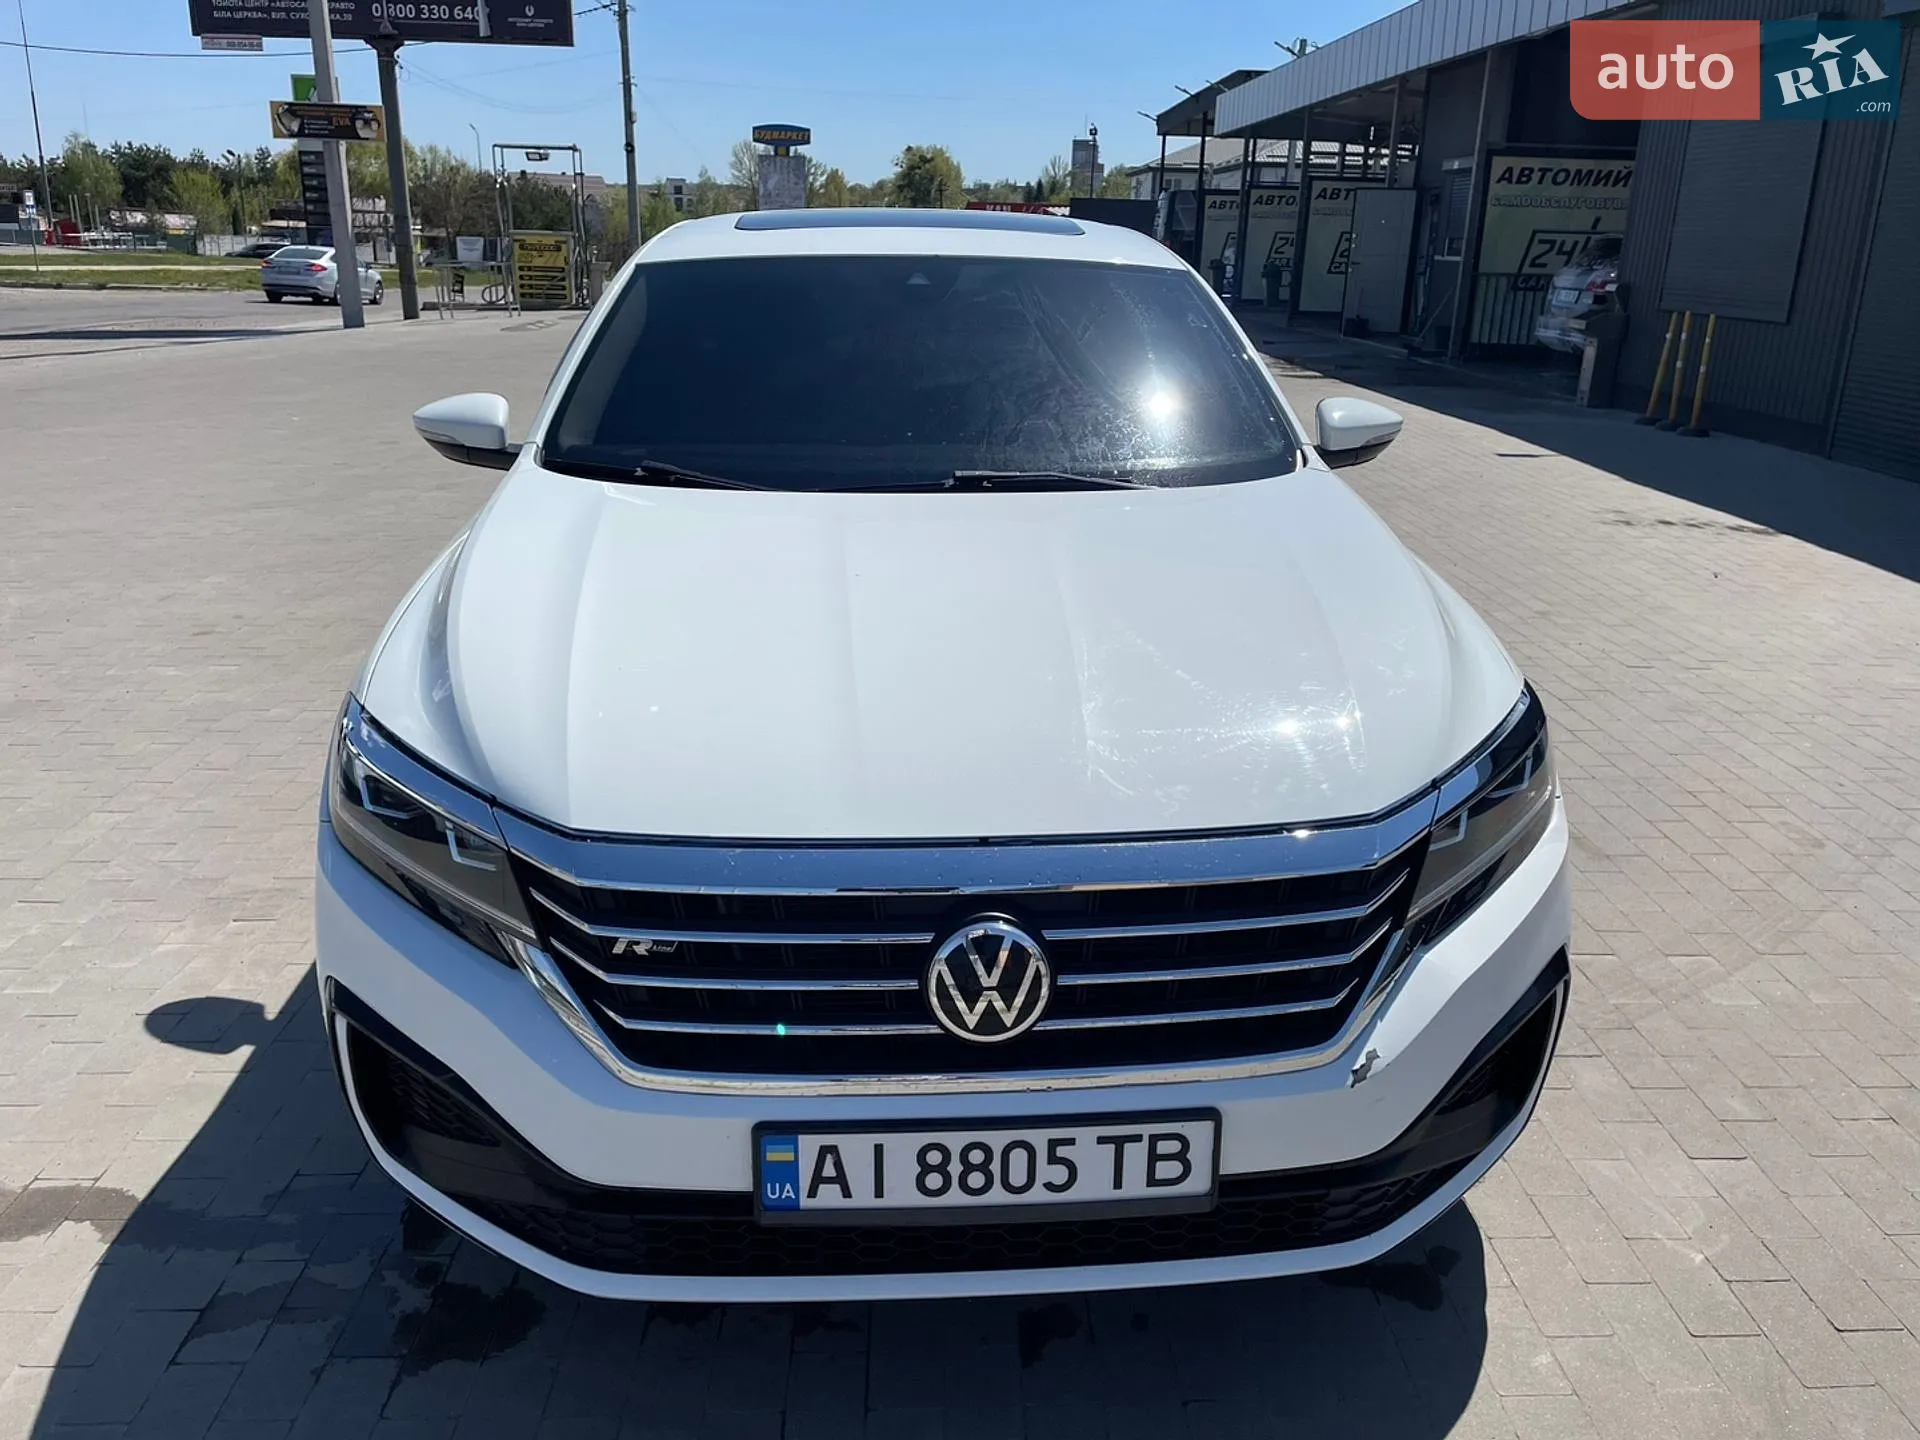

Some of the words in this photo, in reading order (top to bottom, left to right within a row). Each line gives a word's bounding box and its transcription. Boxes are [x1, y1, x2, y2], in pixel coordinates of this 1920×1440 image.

[420, 4, 450, 19] 330
[806, 1142, 884, 1200] AI
[915, 1137, 1078, 1198] 8805
[1096, 1132, 1193, 1191] TB
[766, 1183, 796, 1200] UA
